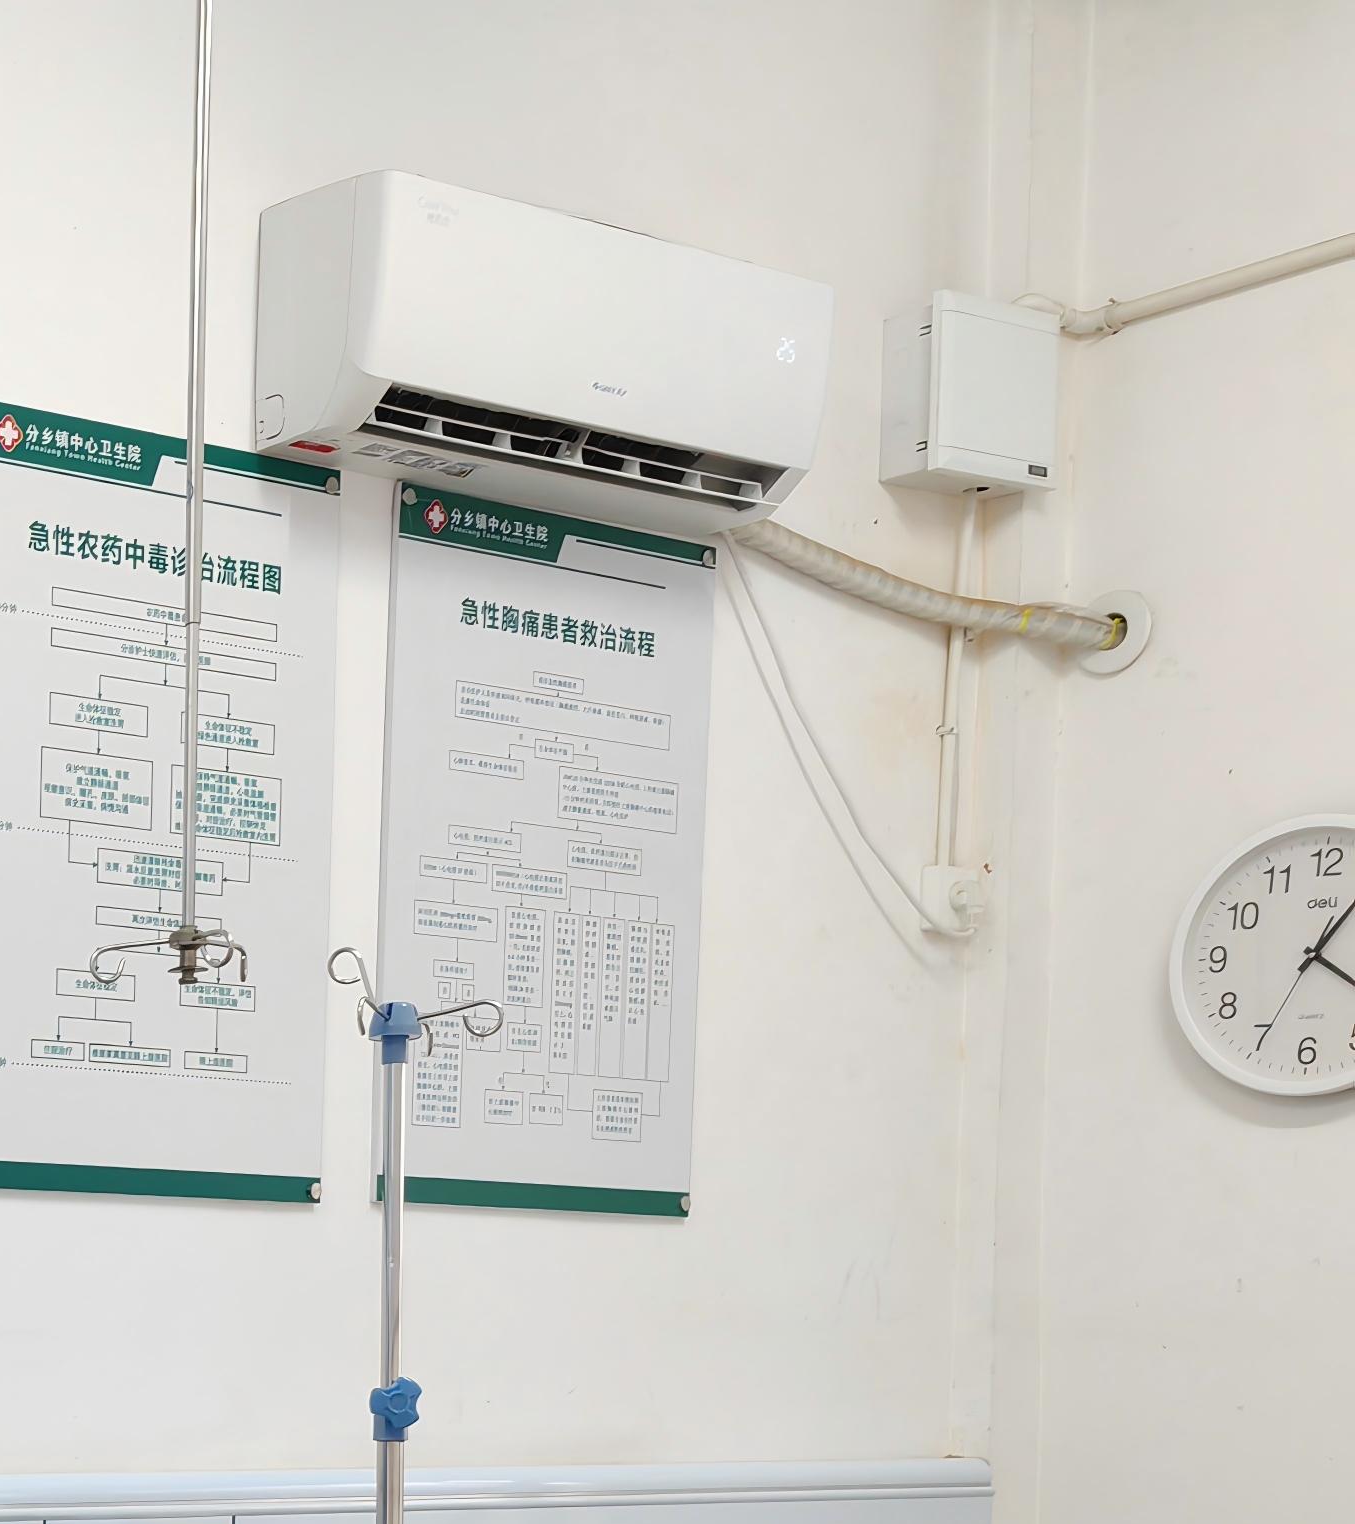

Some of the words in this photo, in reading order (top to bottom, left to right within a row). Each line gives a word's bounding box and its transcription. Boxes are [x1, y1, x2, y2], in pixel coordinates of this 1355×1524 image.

[26, 424, 141, 463] 分乡镇中心卫生院
[451, 508, 548, 542] 分乡镇中心卫生院
[459, 596, 655, 658] 急性胸痛患者救治流程
[1310, 847, 1344, 877] 12
[1263, 863, 1292, 895] 11
[1227, 902, 1259, 930] 10
[1307, 896, 1338, 909] deli
[1209, 945, 1228, 973] 9
[1219, 992, 1237, 1019] 8
[1254, 1023, 1272, 1051] 7
[1297, 1036, 1317, 1064] 6
